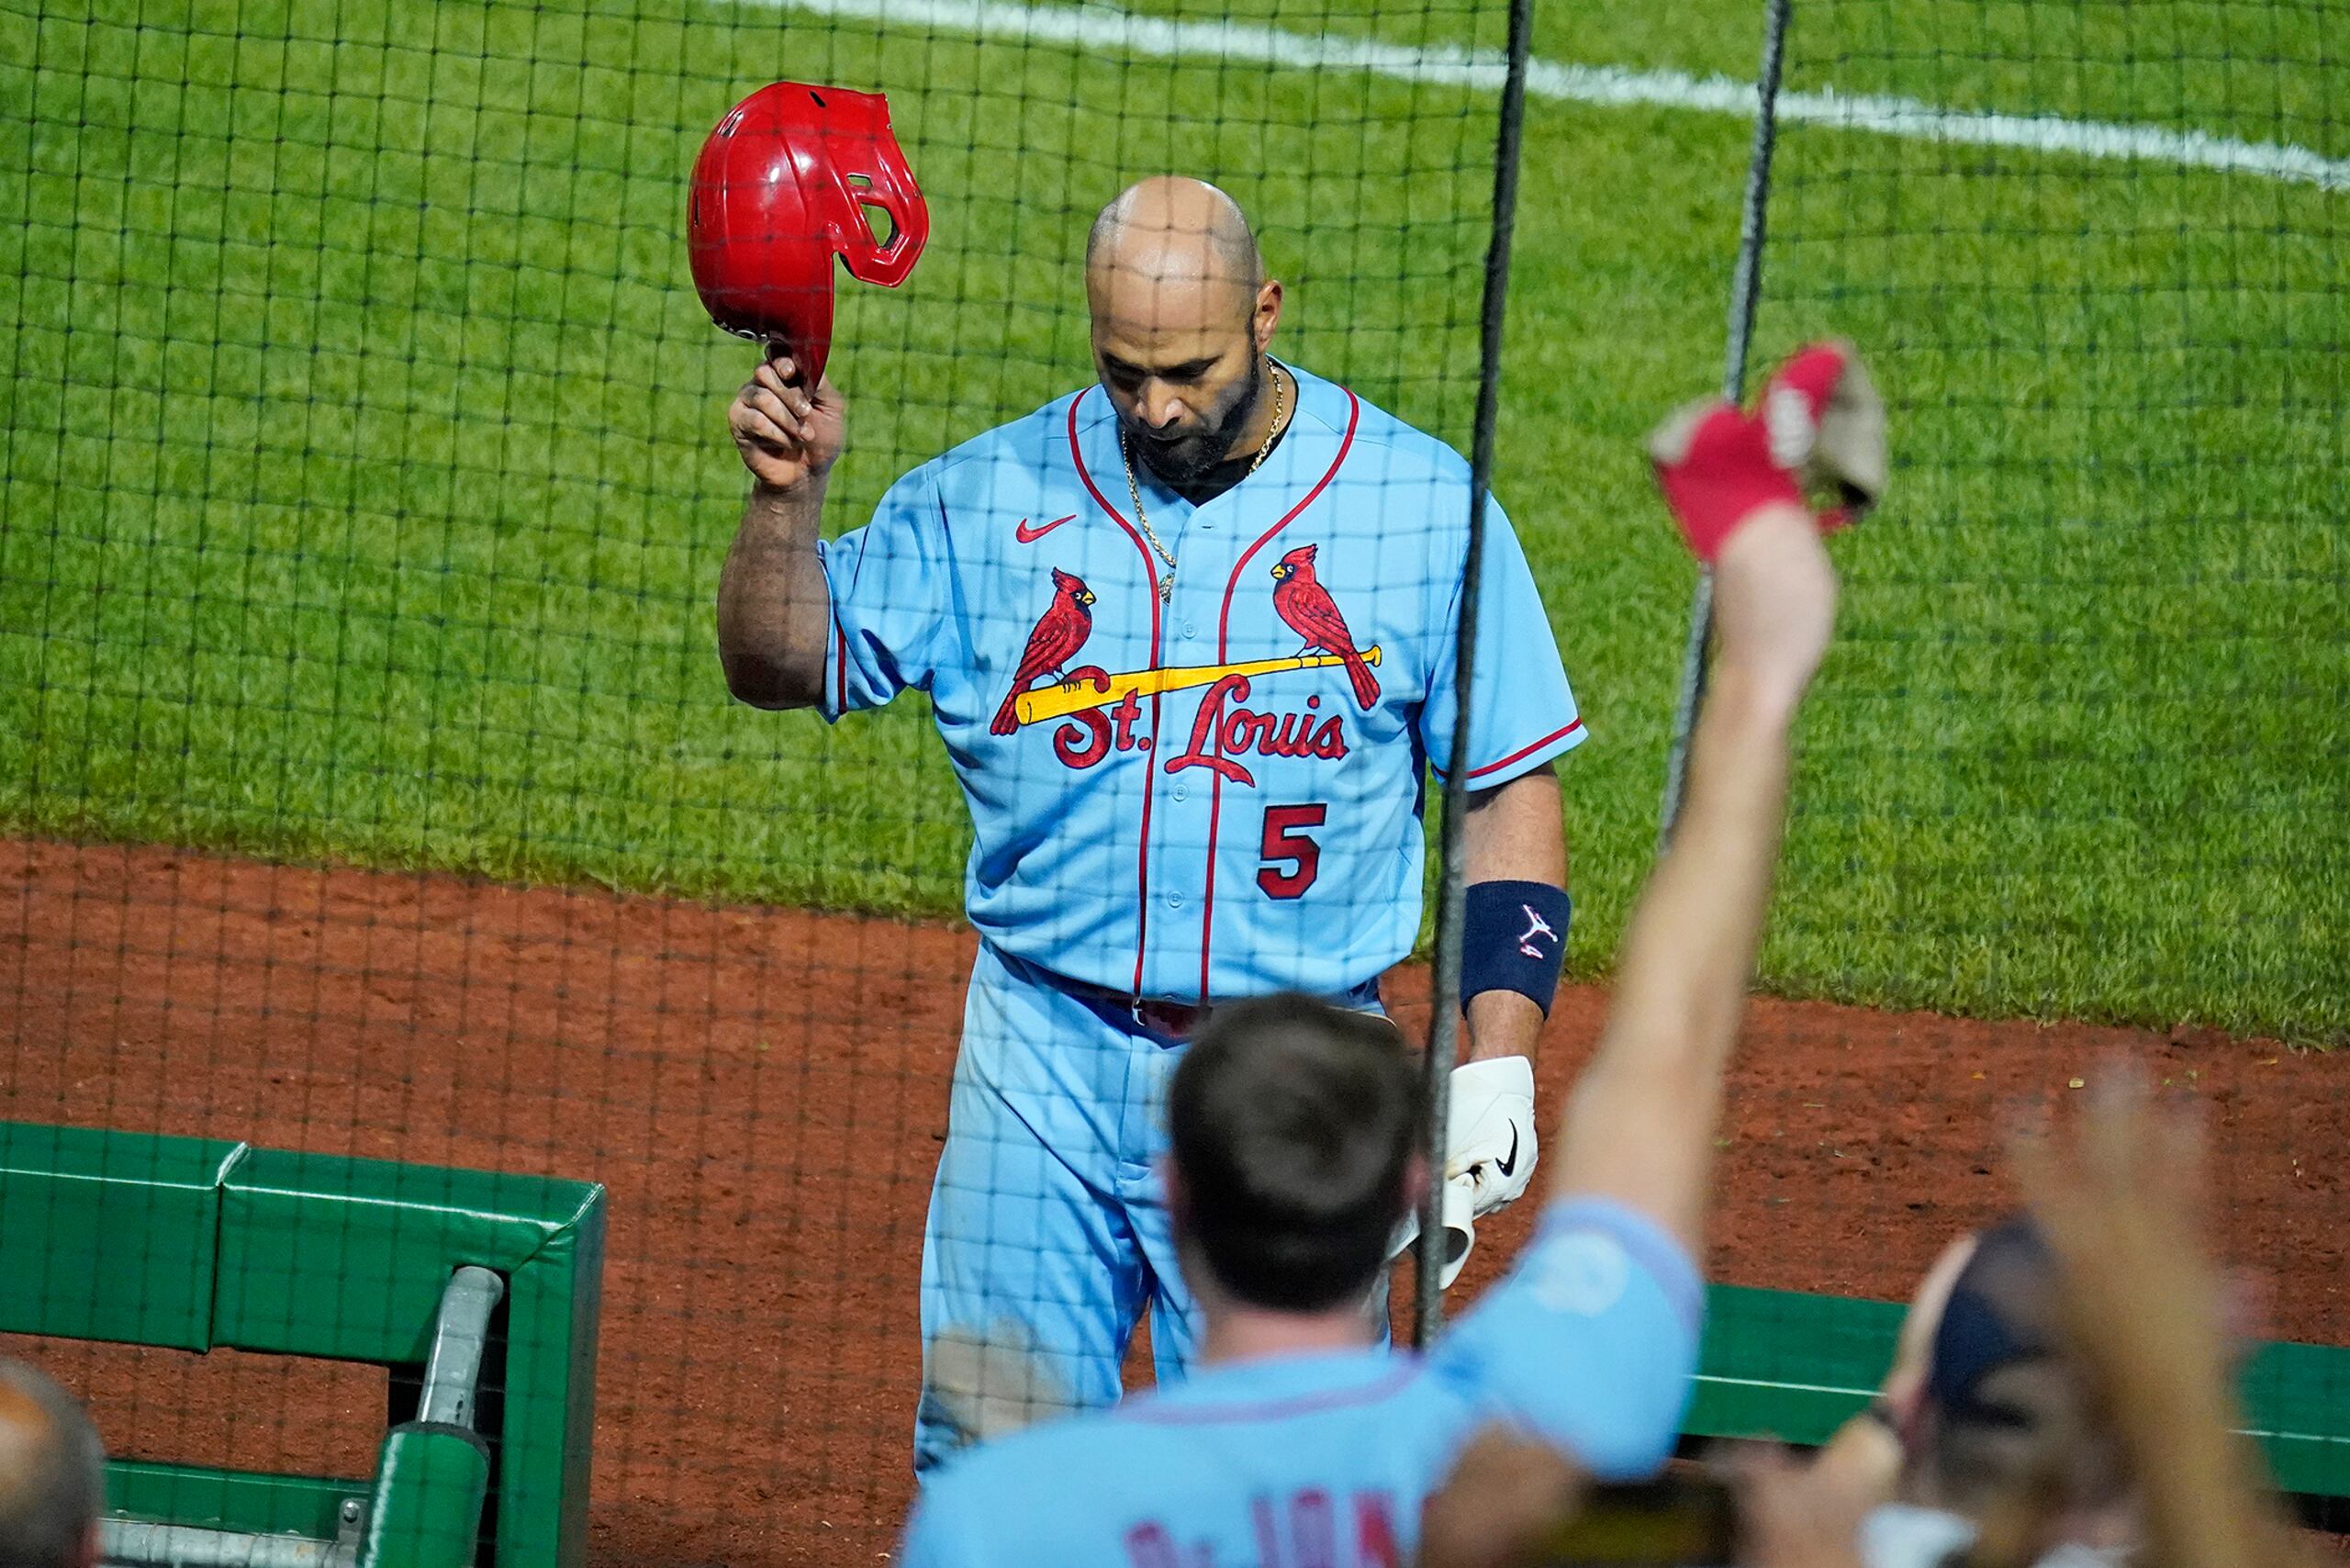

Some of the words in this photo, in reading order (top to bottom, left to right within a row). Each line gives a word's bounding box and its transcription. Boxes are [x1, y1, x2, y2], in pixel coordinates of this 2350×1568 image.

[1053, 666, 1151, 769] St.
[1164, 674, 1349, 788] Louis
[1256, 803, 1327, 900] 5
